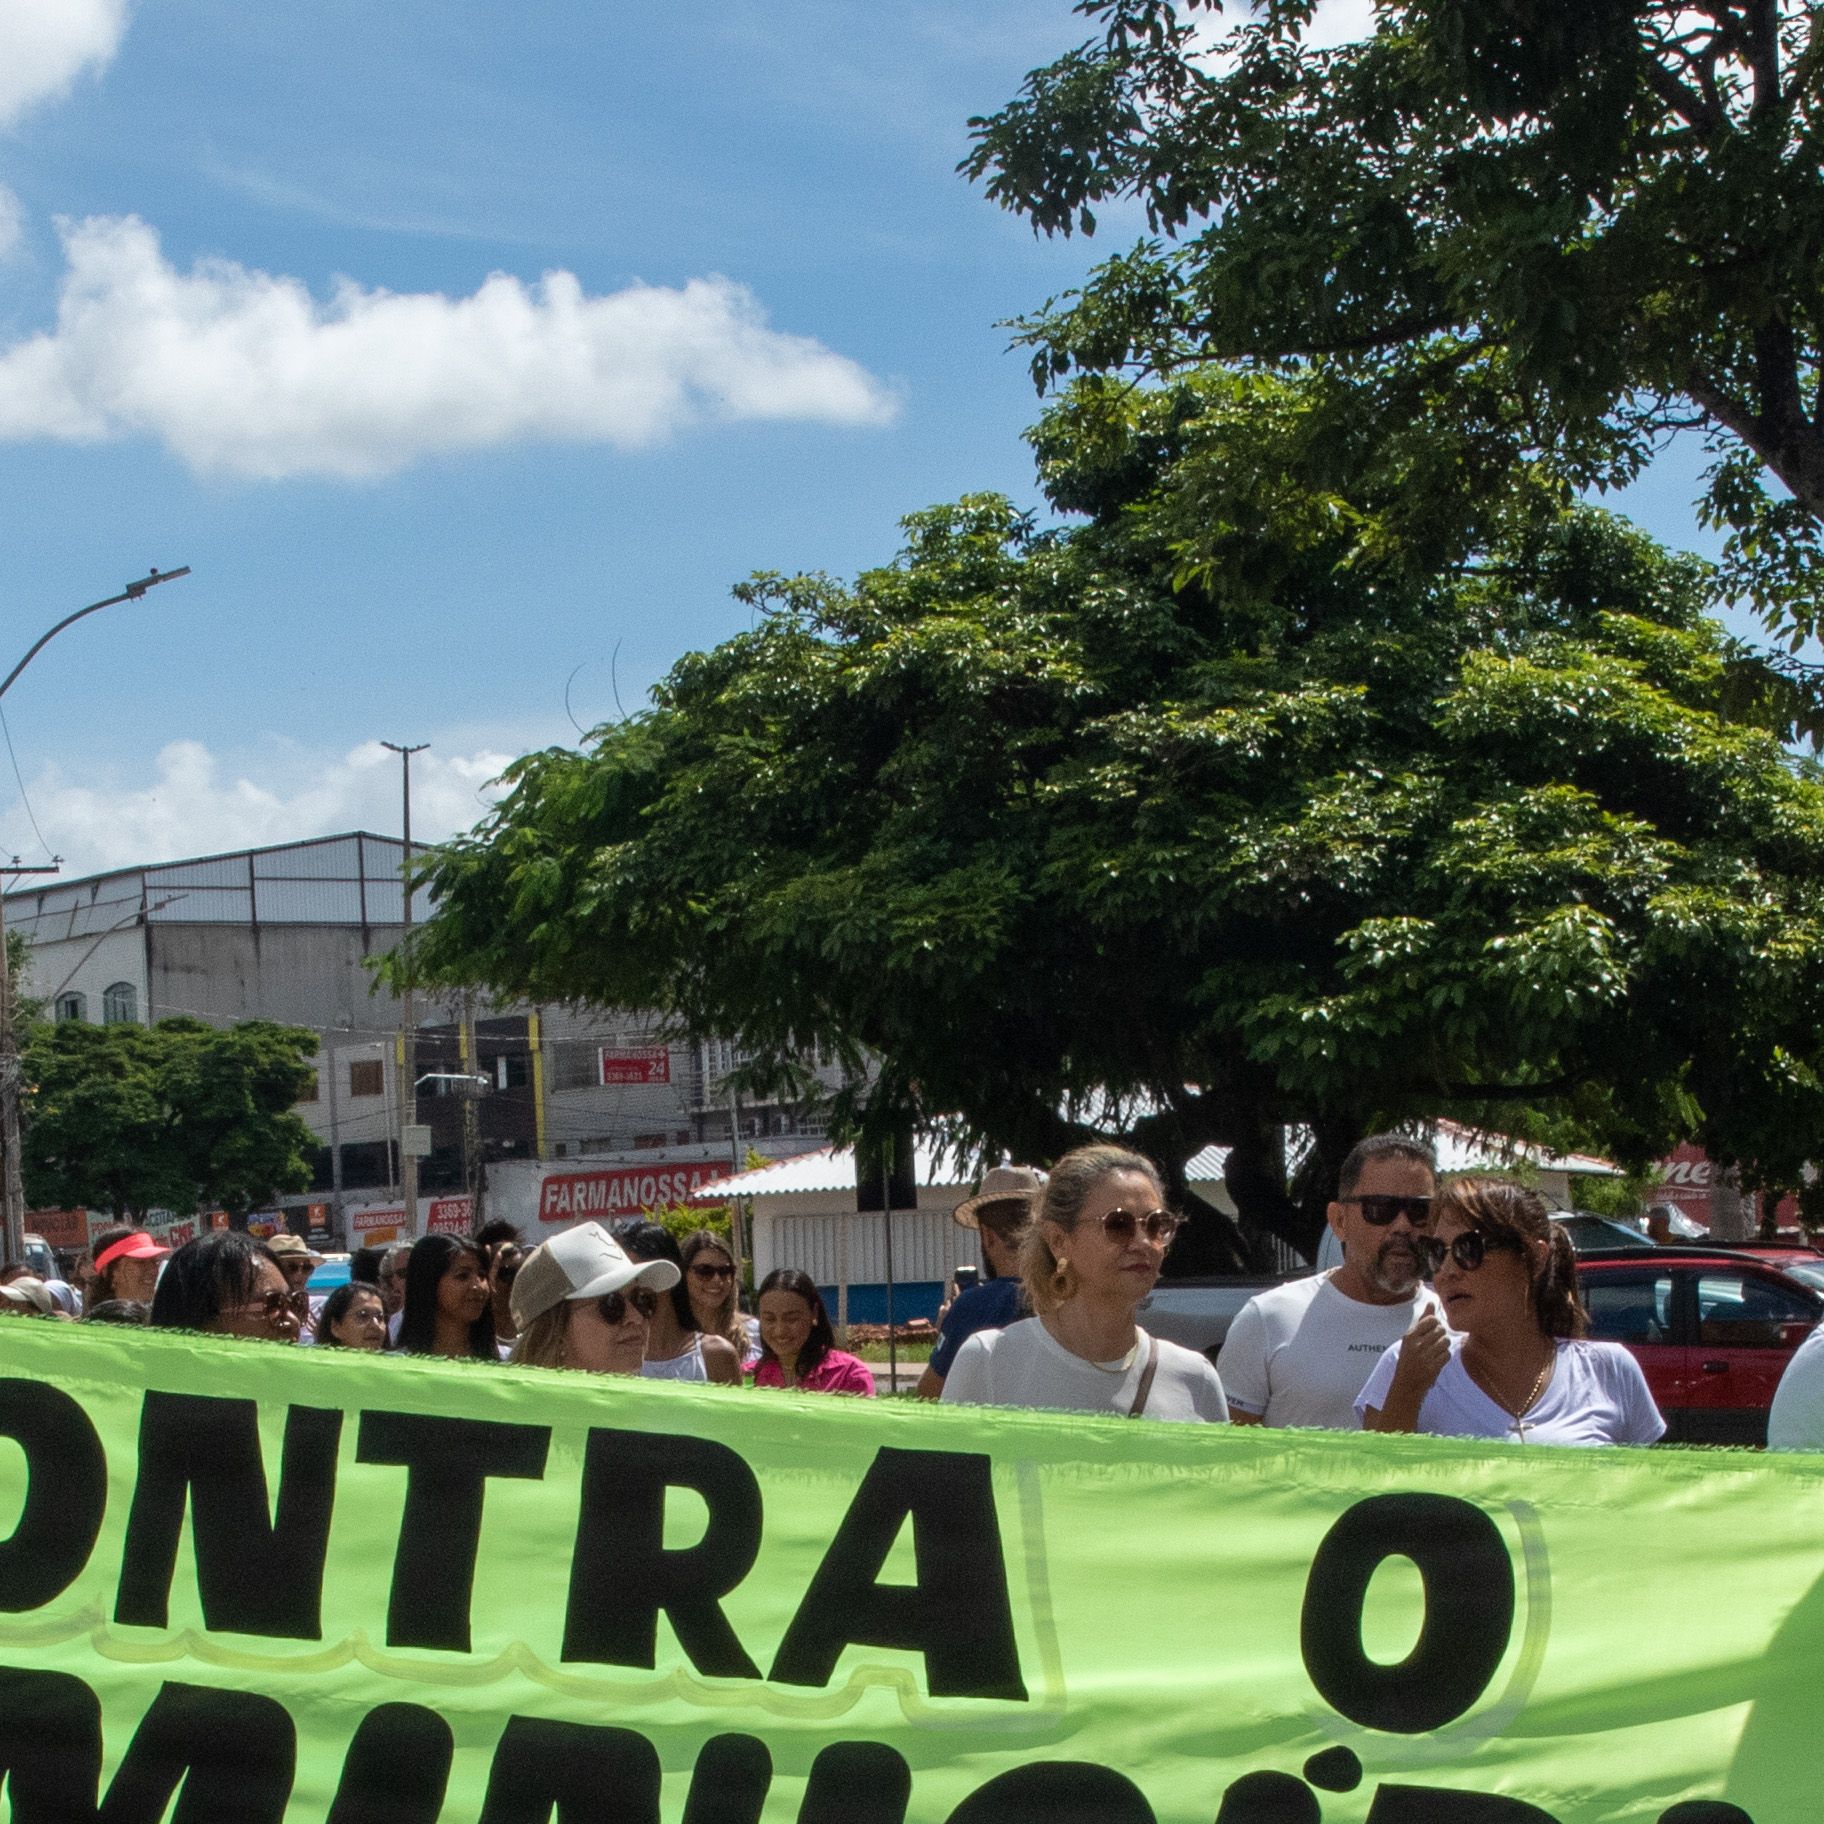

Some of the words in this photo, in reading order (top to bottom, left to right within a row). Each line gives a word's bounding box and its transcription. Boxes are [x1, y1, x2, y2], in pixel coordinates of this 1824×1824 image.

[648, 1061, 665, 1076] 24
[545, 1171, 702, 1214] FARMANOSSA
[1301, 1491, 1516, 1734] O
